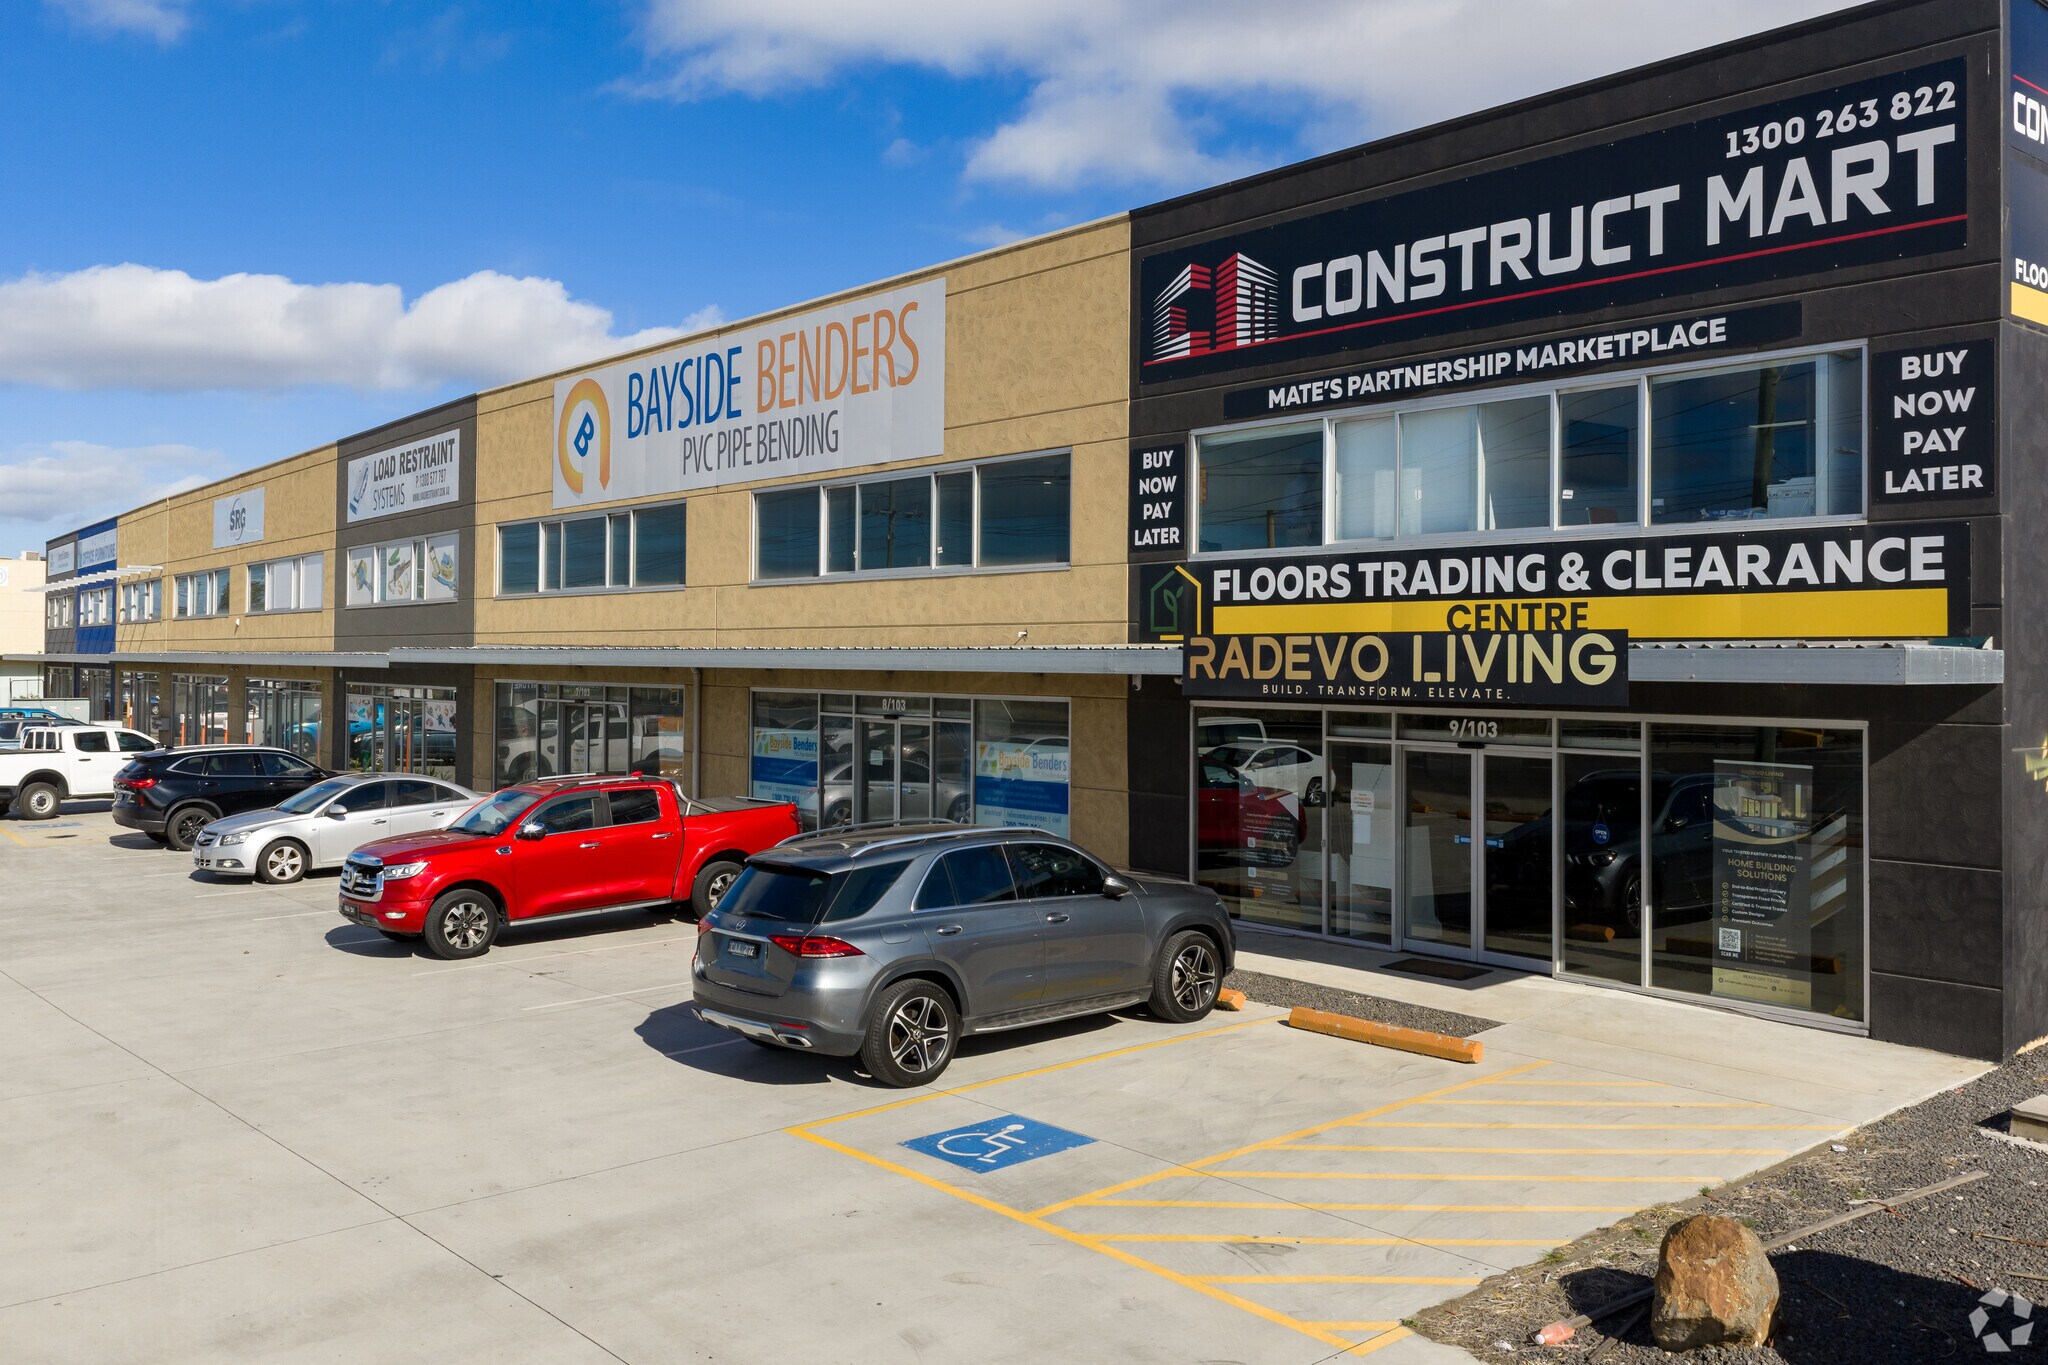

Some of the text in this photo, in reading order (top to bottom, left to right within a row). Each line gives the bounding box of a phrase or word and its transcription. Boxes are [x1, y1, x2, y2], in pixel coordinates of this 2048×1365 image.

[1726, 80, 1956, 159] 1300 263 822
[1292, 123, 1956, 324] CONSTRUCT MART
[627, 301, 920, 440] BAYSIDE BENDERS
[1268, 317, 1727, 409] MATE'S PARTNERSHIP MARKETPLACE
[1901, 349, 1968, 381] BUY
[1893, 387, 1976, 419] NOW
[682, 409, 840, 476] PVC PIPE BENDING
[1903, 426, 1967, 456] PAY
[373, 437, 455, 482] LOAD RESTRAINT
[1142, 449, 1174, 470] BUY
[1139, 475, 1177, 496] NOW
[1885, 464, 1984, 494] LATER
[373, 482, 405, 511] SYSTEMS
[1143, 501, 1172, 520] PAY
[229, 507, 246, 531] SRG
[1134, 526, 1180, 546] LATER
[1213, 535, 1946, 601] FLOORS TRADING & CLEARANCE
[1446, 602, 1589, 631] CENTRE
[1189, 633, 1617, 685] RADEVO LIVING
[882, 698, 906, 711] 8/103
[1262, 684, 1511, 699] BUILD. TRANSFORM. ELEVATE.
[770, 734, 818, 752] Bayside Benders
[1449, 719, 1498, 738] 9/103
[999, 750, 1067, 771] Bayside Benders
[1728, 859, 1797, 873] HOME BUILDING
[1737, 870, 1787, 882] SOLUTIONS
